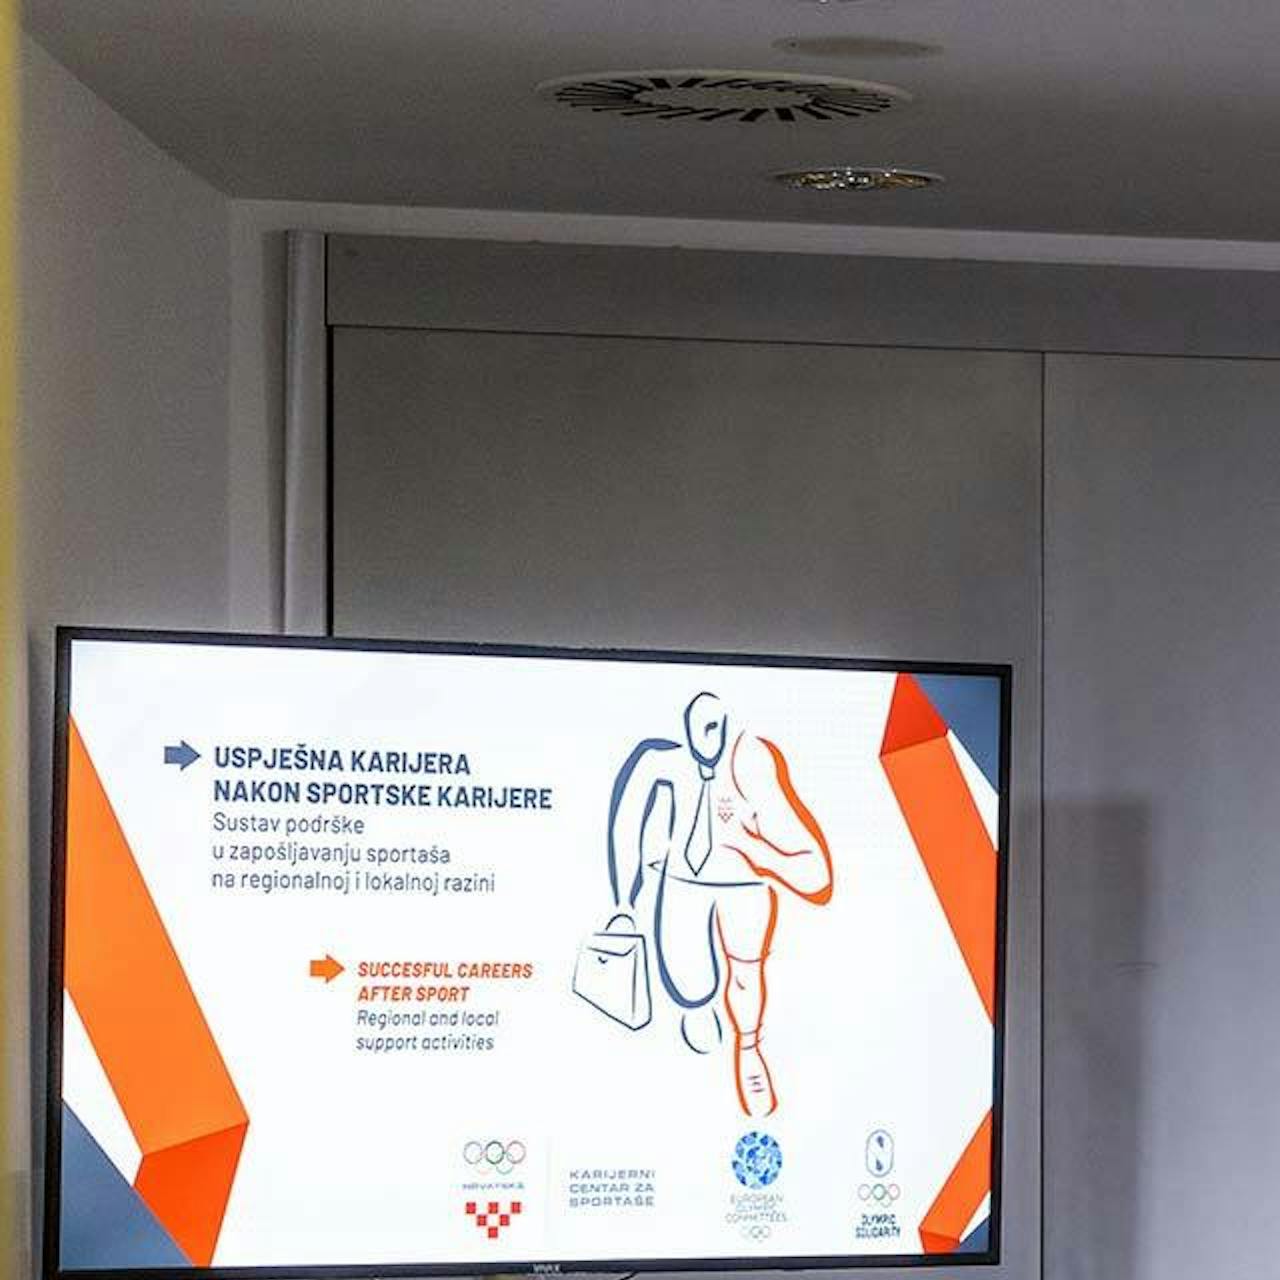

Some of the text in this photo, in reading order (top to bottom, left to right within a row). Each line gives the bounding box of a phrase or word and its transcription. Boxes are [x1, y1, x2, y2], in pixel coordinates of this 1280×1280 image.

[215, 743, 471, 776] USPJEŠNA KARIJERA
[214, 780, 552, 810] NAKON SPORTSKE KARIJERE
[214, 812, 364, 837] Sustav podrške
[213, 842, 450, 867] u zapošljavanju sportaša
[212, 873, 235, 888] na
[241, 870, 350, 895] regionalnoj
[366, 872, 438, 896] lokalnoj
[444, 873, 494, 892] razini
[358, 962, 533, 979] SUCCESFUL CAREERS
[358, 986, 470, 1002] AFTER SPORT
[358, 1010, 499, 1030] Regional and local
[356, 1034, 494, 1053] support activities
